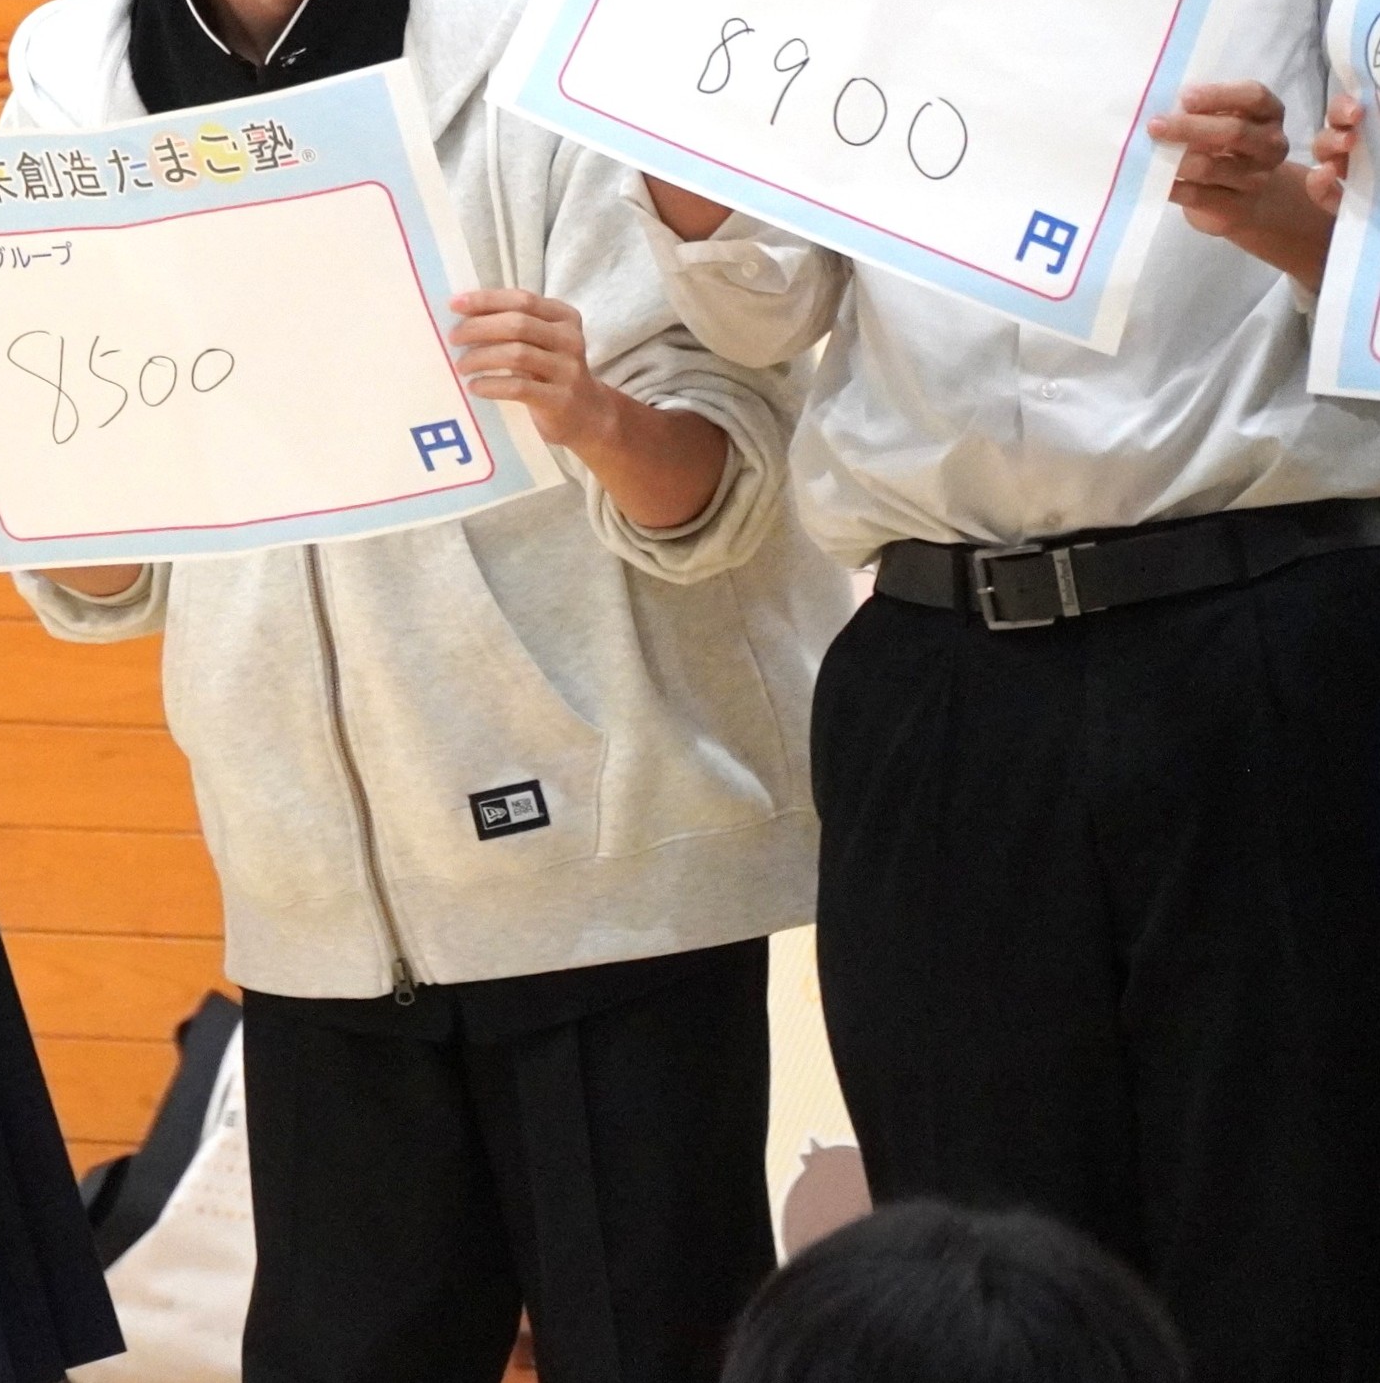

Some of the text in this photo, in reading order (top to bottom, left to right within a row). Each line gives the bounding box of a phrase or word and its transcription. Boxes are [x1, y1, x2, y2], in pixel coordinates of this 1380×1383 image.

[697, 18, 1079, 275] 8900 円
[7, 330, 473, 472] 8500 円
